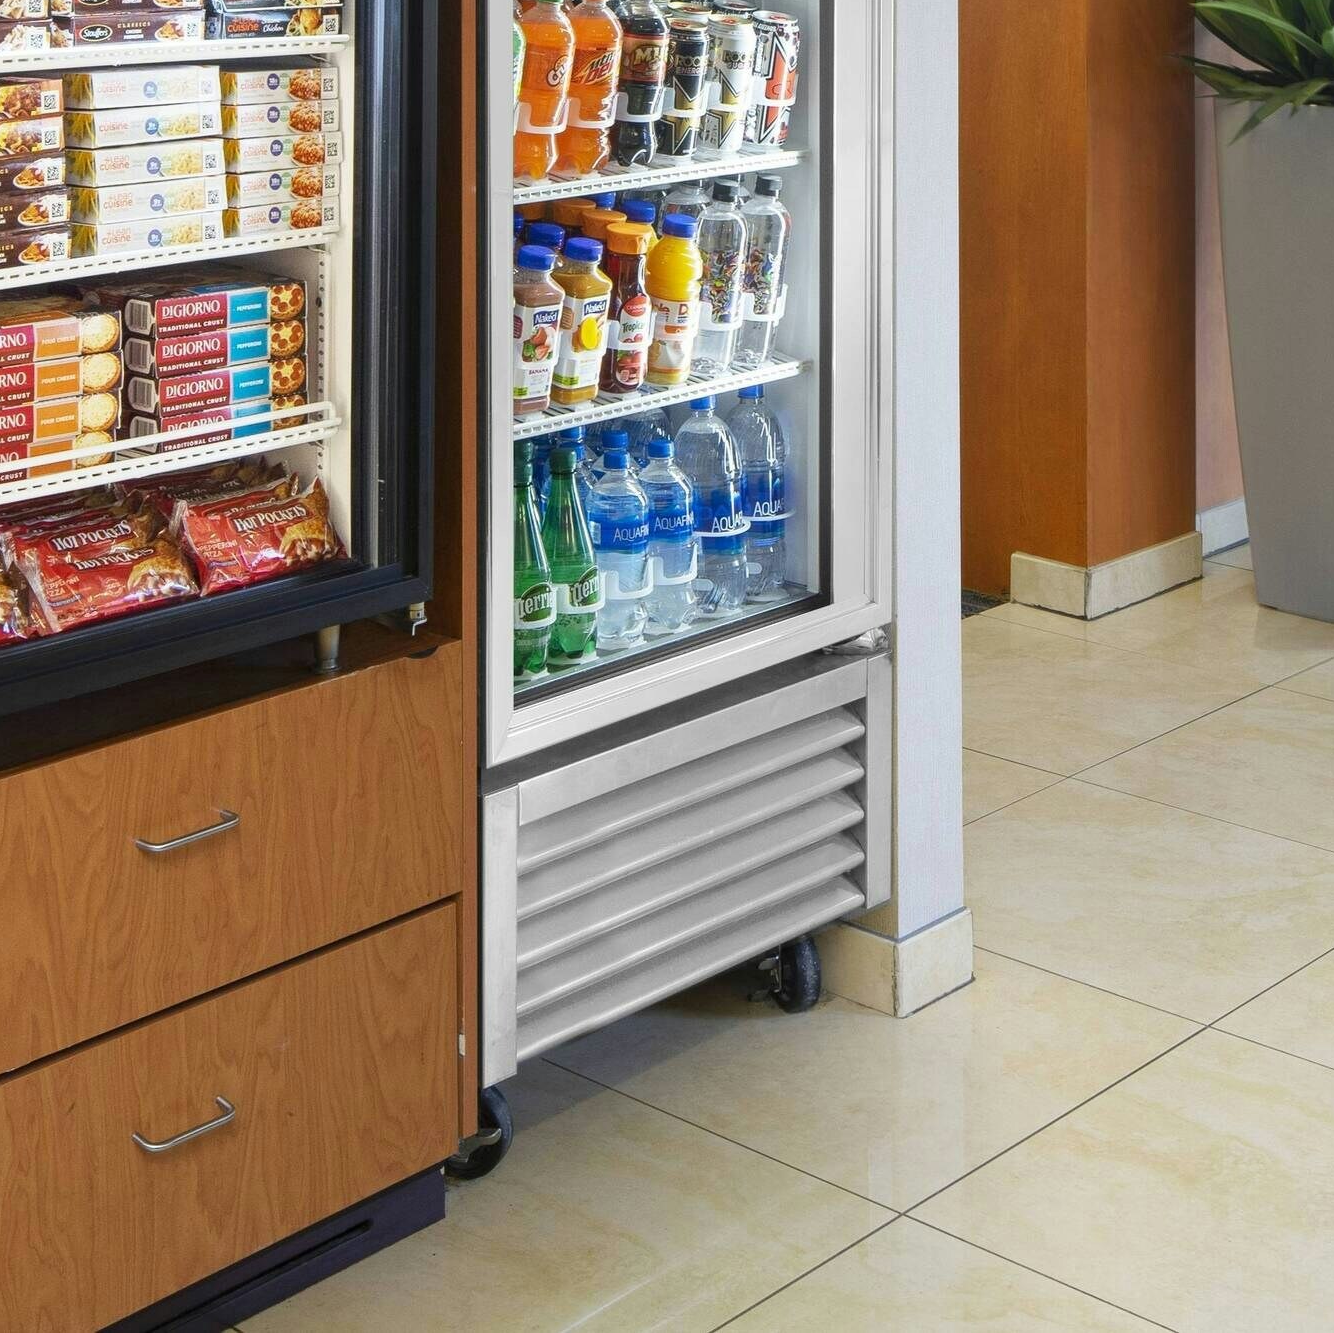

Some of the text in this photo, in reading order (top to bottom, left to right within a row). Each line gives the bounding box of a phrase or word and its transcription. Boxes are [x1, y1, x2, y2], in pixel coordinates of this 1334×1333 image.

[162, 299, 221, 320] DIGIORNO
[158, 319, 224, 333] TRADITIONAL CRUST
[162, 338, 221, 359] DIGIORNO
[7, 353, 30, 361] CRUST
[158, 357, 224, 372] TRADITIONAL CRUST
[165, 377, 224, 398] DIGIORNO
[8, 392, 31, 401] CRUST
[162, 396, 227, 412] TRADITIONAL CRUST
[7, 433, 30, 442] CRUST
[164, 434, 229, 451] TRADITIONAL CRUST
[0, 472, 23, 481] CRUST
[233, 503, 307, 532] HOT POCKETS
